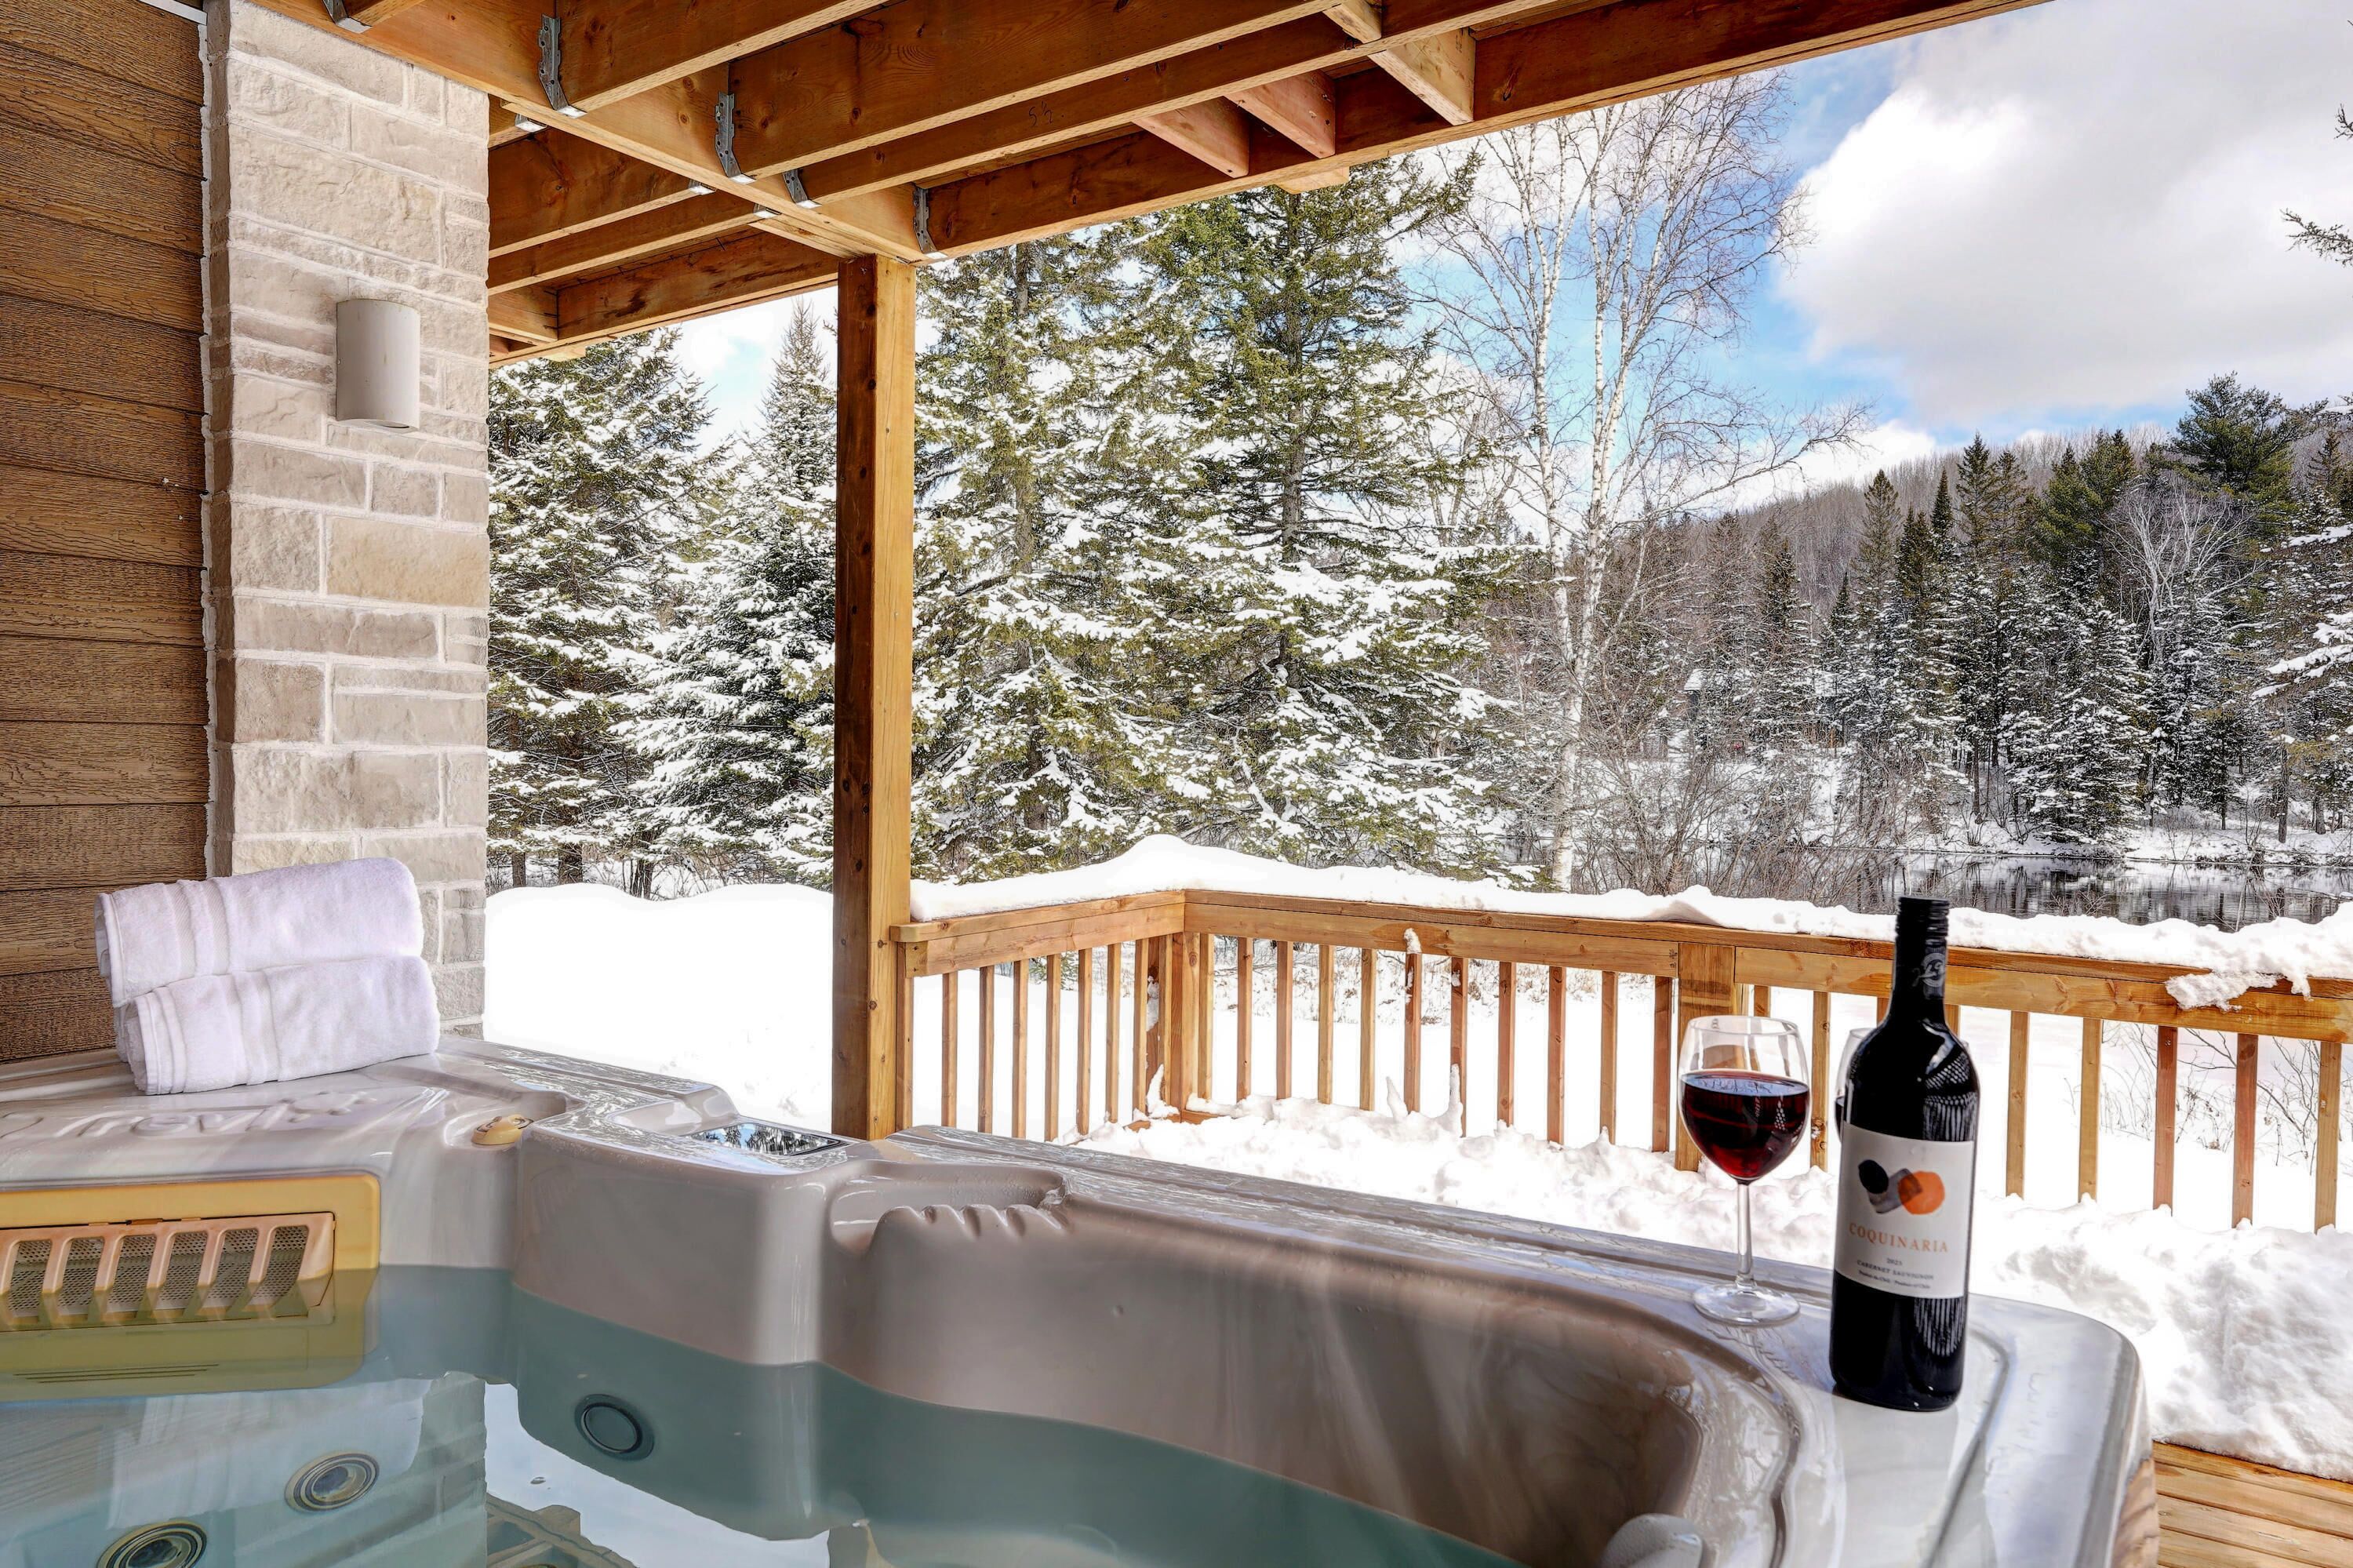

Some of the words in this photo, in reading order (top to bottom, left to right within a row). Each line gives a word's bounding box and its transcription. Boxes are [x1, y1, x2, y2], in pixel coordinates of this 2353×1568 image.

[1849, 1223, 1947, 1253] COQUINARIA
[1857, 1260, 1890, 1273] CABERNET
[1893, 1269, 1934, 1280] SAUVIGNON
